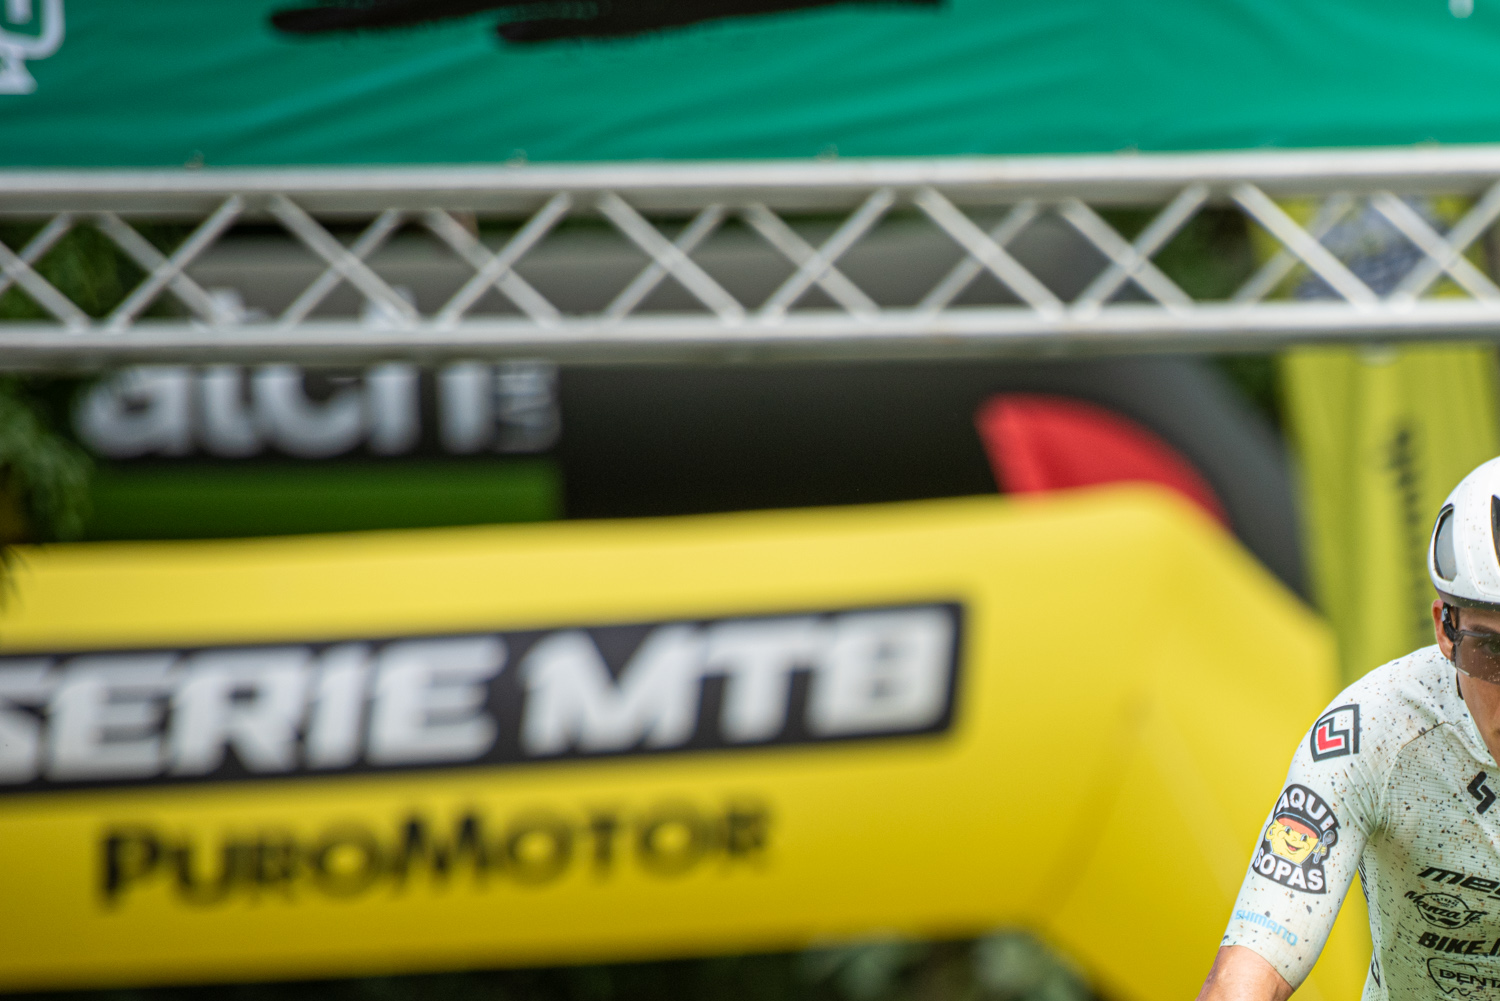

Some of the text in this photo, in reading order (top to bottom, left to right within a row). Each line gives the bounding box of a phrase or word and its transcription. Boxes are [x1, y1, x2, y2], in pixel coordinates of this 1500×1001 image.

[520, 605, 958, 757] MTB
[1275, 787, 1335, 832] AQUI
[1254, 847, 1324, 891] SOPAS
[1234, 909, 1299, 947] SHIMANO
[1417, 931, 1486, 956] BIKE
